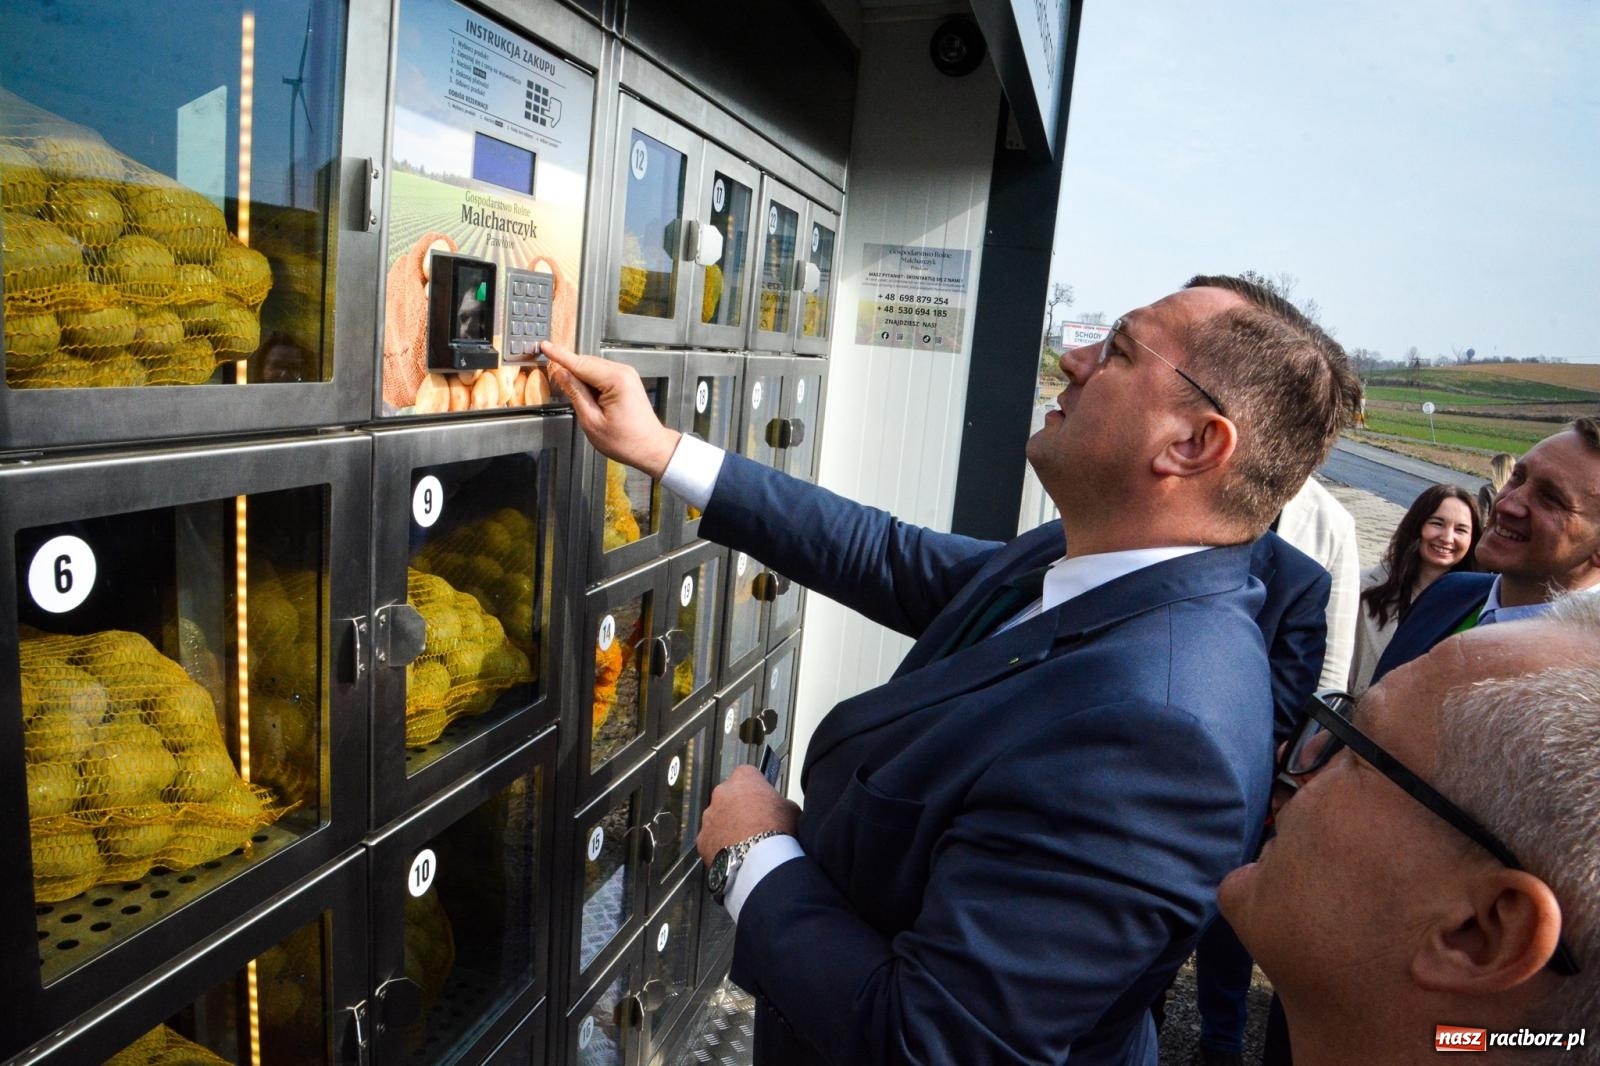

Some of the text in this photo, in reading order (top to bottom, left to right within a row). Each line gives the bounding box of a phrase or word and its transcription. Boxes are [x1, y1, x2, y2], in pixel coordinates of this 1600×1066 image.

[466, 18, 556, 76] INSTRUKCJA ZAKUPU
[636, 148, 645, 171] 12
[466, 190, 512, 212] Gospodarstwo
[716, 186, 722, 204] 17
[461, 204, 537, 241] Malcharczyk
[1075, 330, 1102, 340] SCHODY
[424, 488, 432, 514] 9
[54, 554, 73, 594] 6
[684, 583, 690, 599] 19
[603, 623, 611, 643] 14
[670, 762, 677, 780] 20
[592, 833, 600, 854] 15
[414, 858, 429, 888] 10
[584, 1022, 590, 1041] 16
